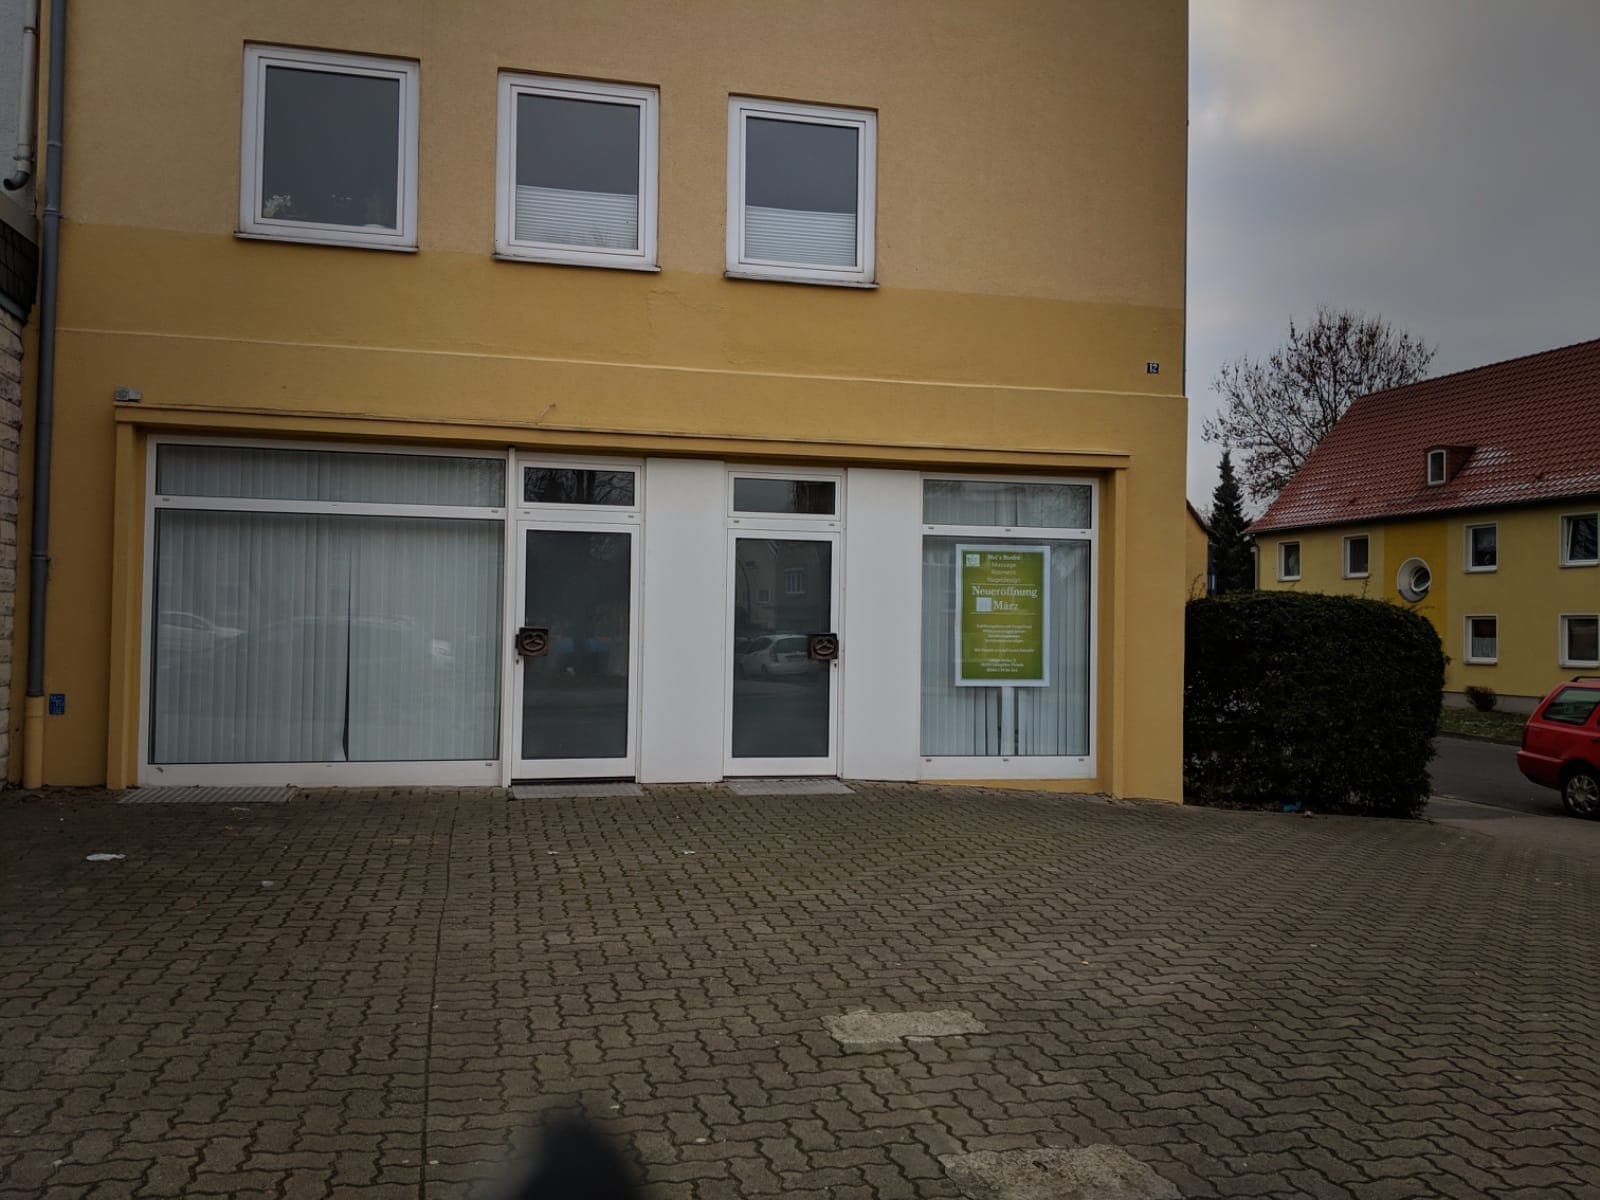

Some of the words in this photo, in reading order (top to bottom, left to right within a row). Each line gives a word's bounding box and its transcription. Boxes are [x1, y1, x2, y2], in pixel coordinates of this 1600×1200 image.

[1149, 363, 1158, 373] 12
[971, 585, 1038, 598] Neueröffnung
[993, 599, 1018, 611] März
